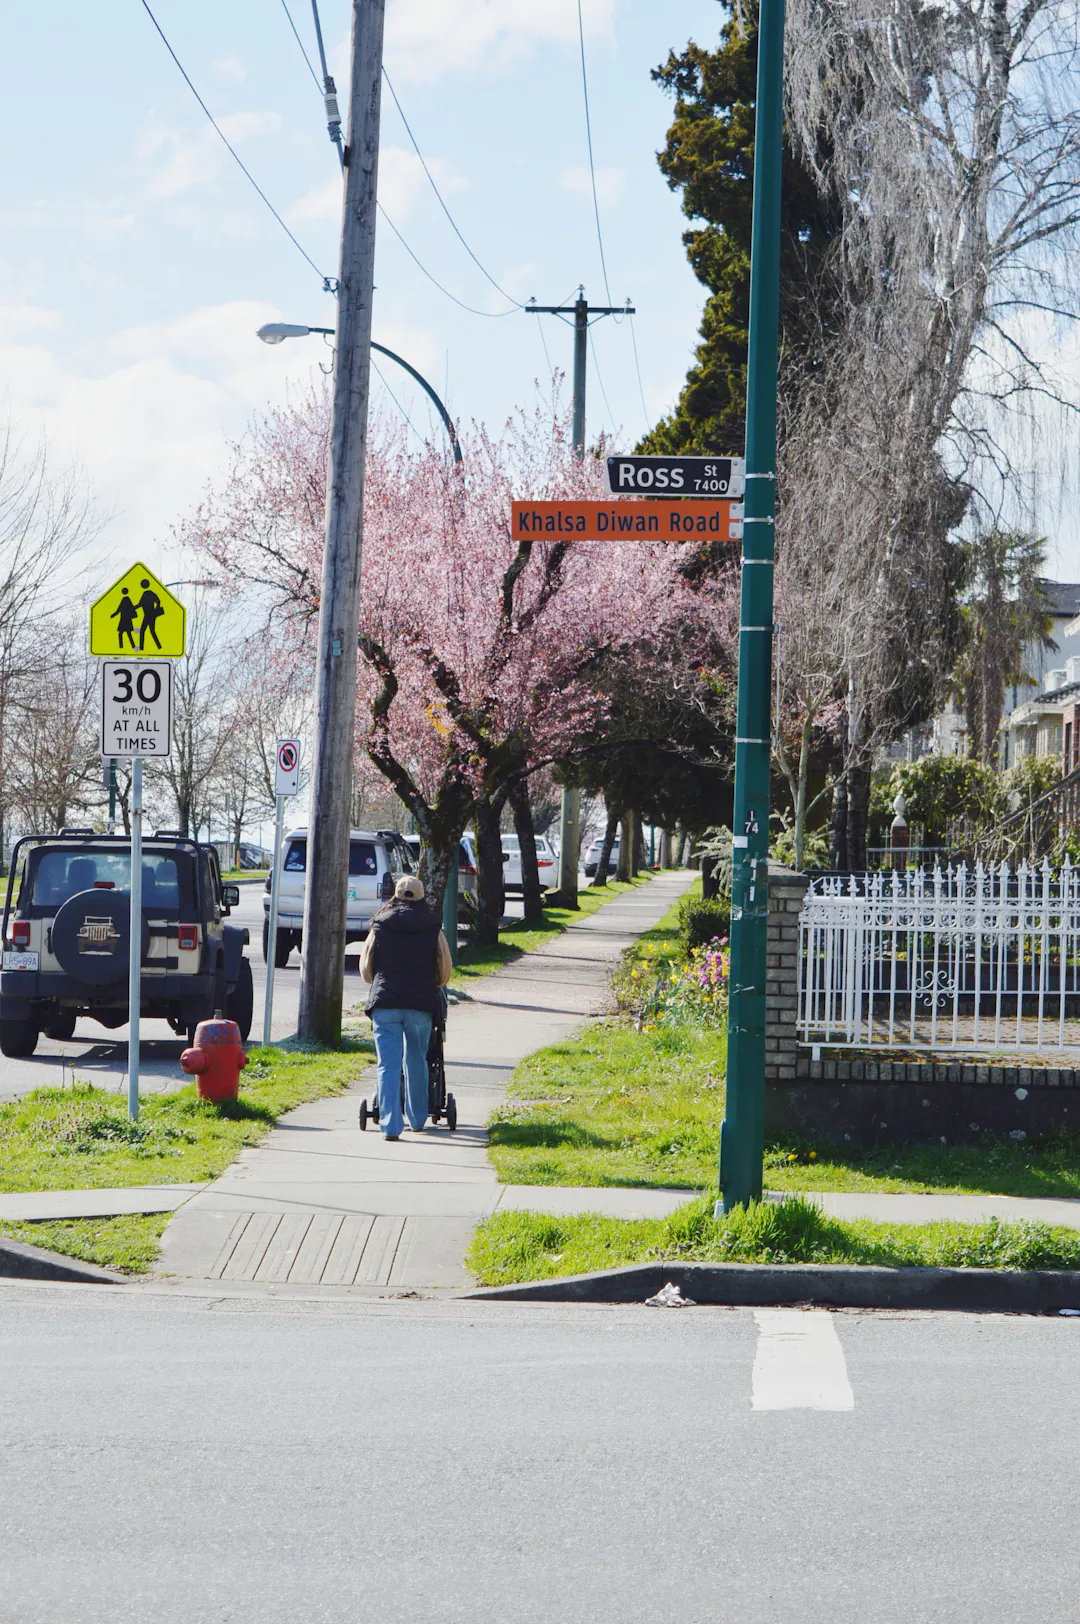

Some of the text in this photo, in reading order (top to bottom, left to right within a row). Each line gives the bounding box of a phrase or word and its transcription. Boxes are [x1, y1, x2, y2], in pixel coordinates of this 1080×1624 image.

[704, 464, 717, 477] St
[694, 479, 728, 492] 7400
[519, 510, 720, 532] Khalsa Diwan Road
[112, 668, 162, 703] 30
[122, 705, 151, 716] km/h
[113, 720, 160, 732] AT ALL
[117, 738, 156, 750] TIMES
[744, 822, 759, 834] 74
